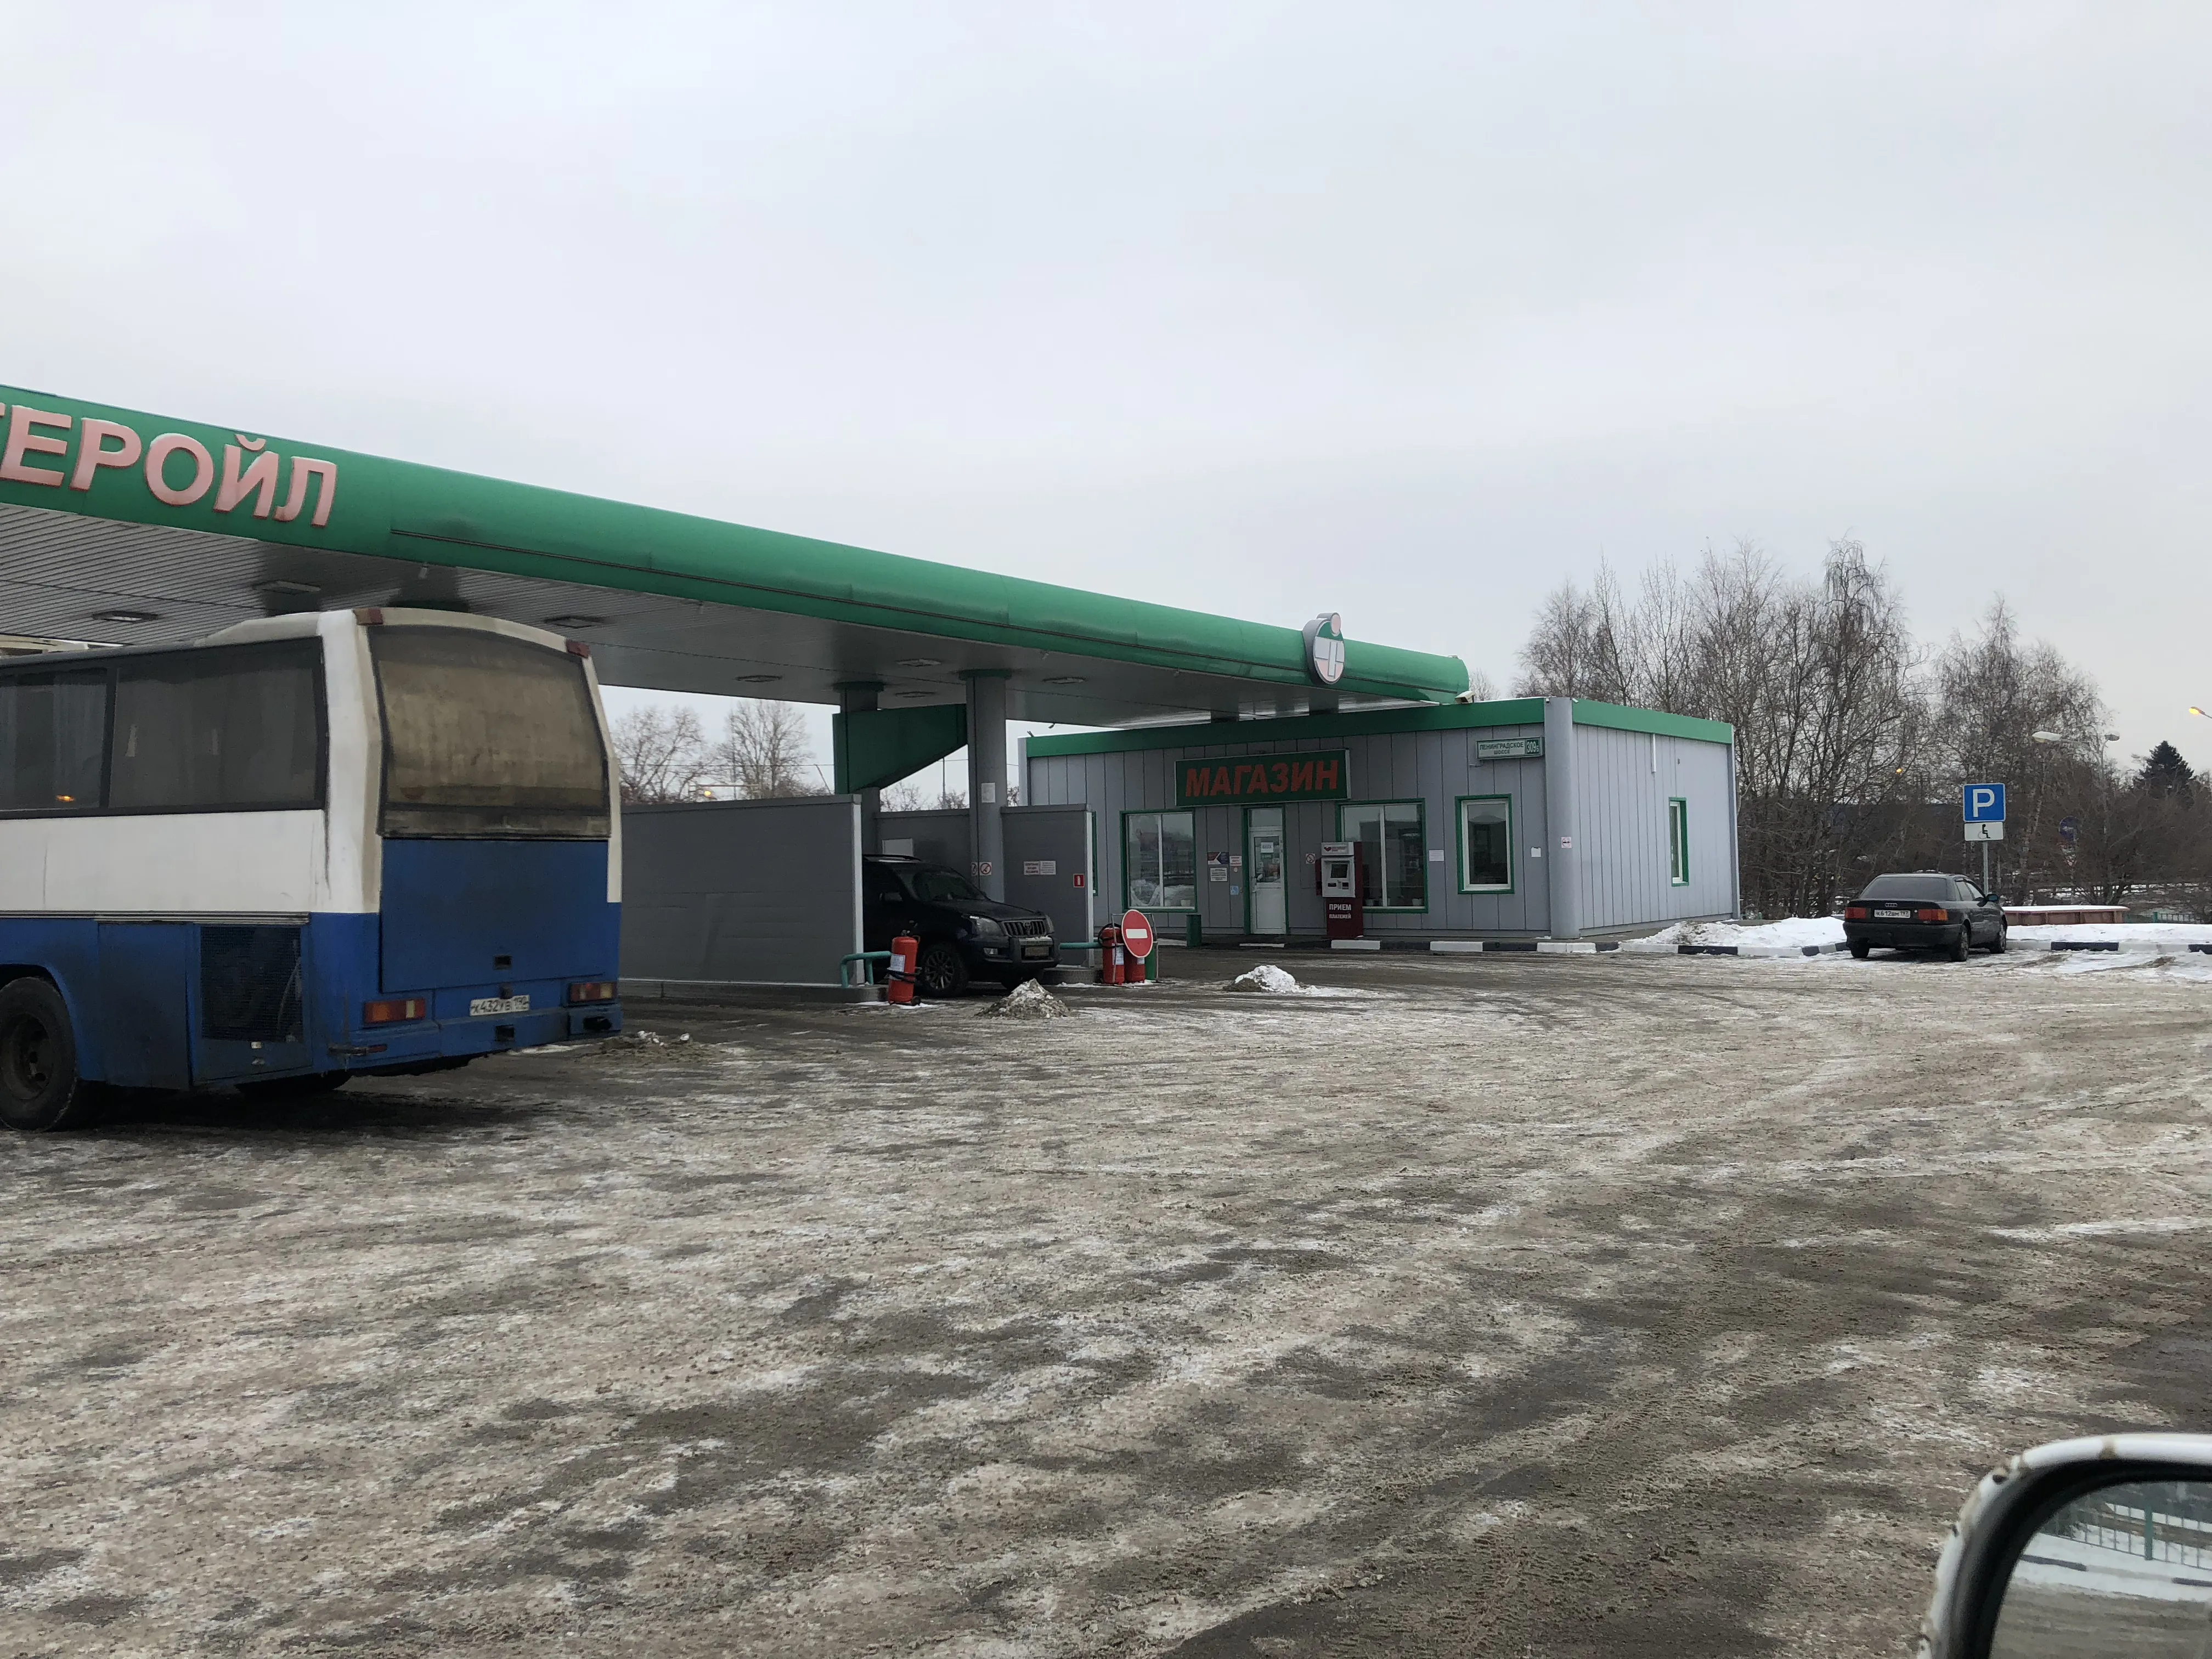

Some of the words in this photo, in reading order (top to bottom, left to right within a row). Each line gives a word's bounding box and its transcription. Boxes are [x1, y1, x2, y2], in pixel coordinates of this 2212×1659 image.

[0, 402, 338, 527] ЕРОЙЛ
[1480, 742, 1523, 750] ЛЕНИНГРАДСКОЕ
[1186, 760, 1339, 797] МАГАЗИН
[1973, 788, 1995, 817] P
